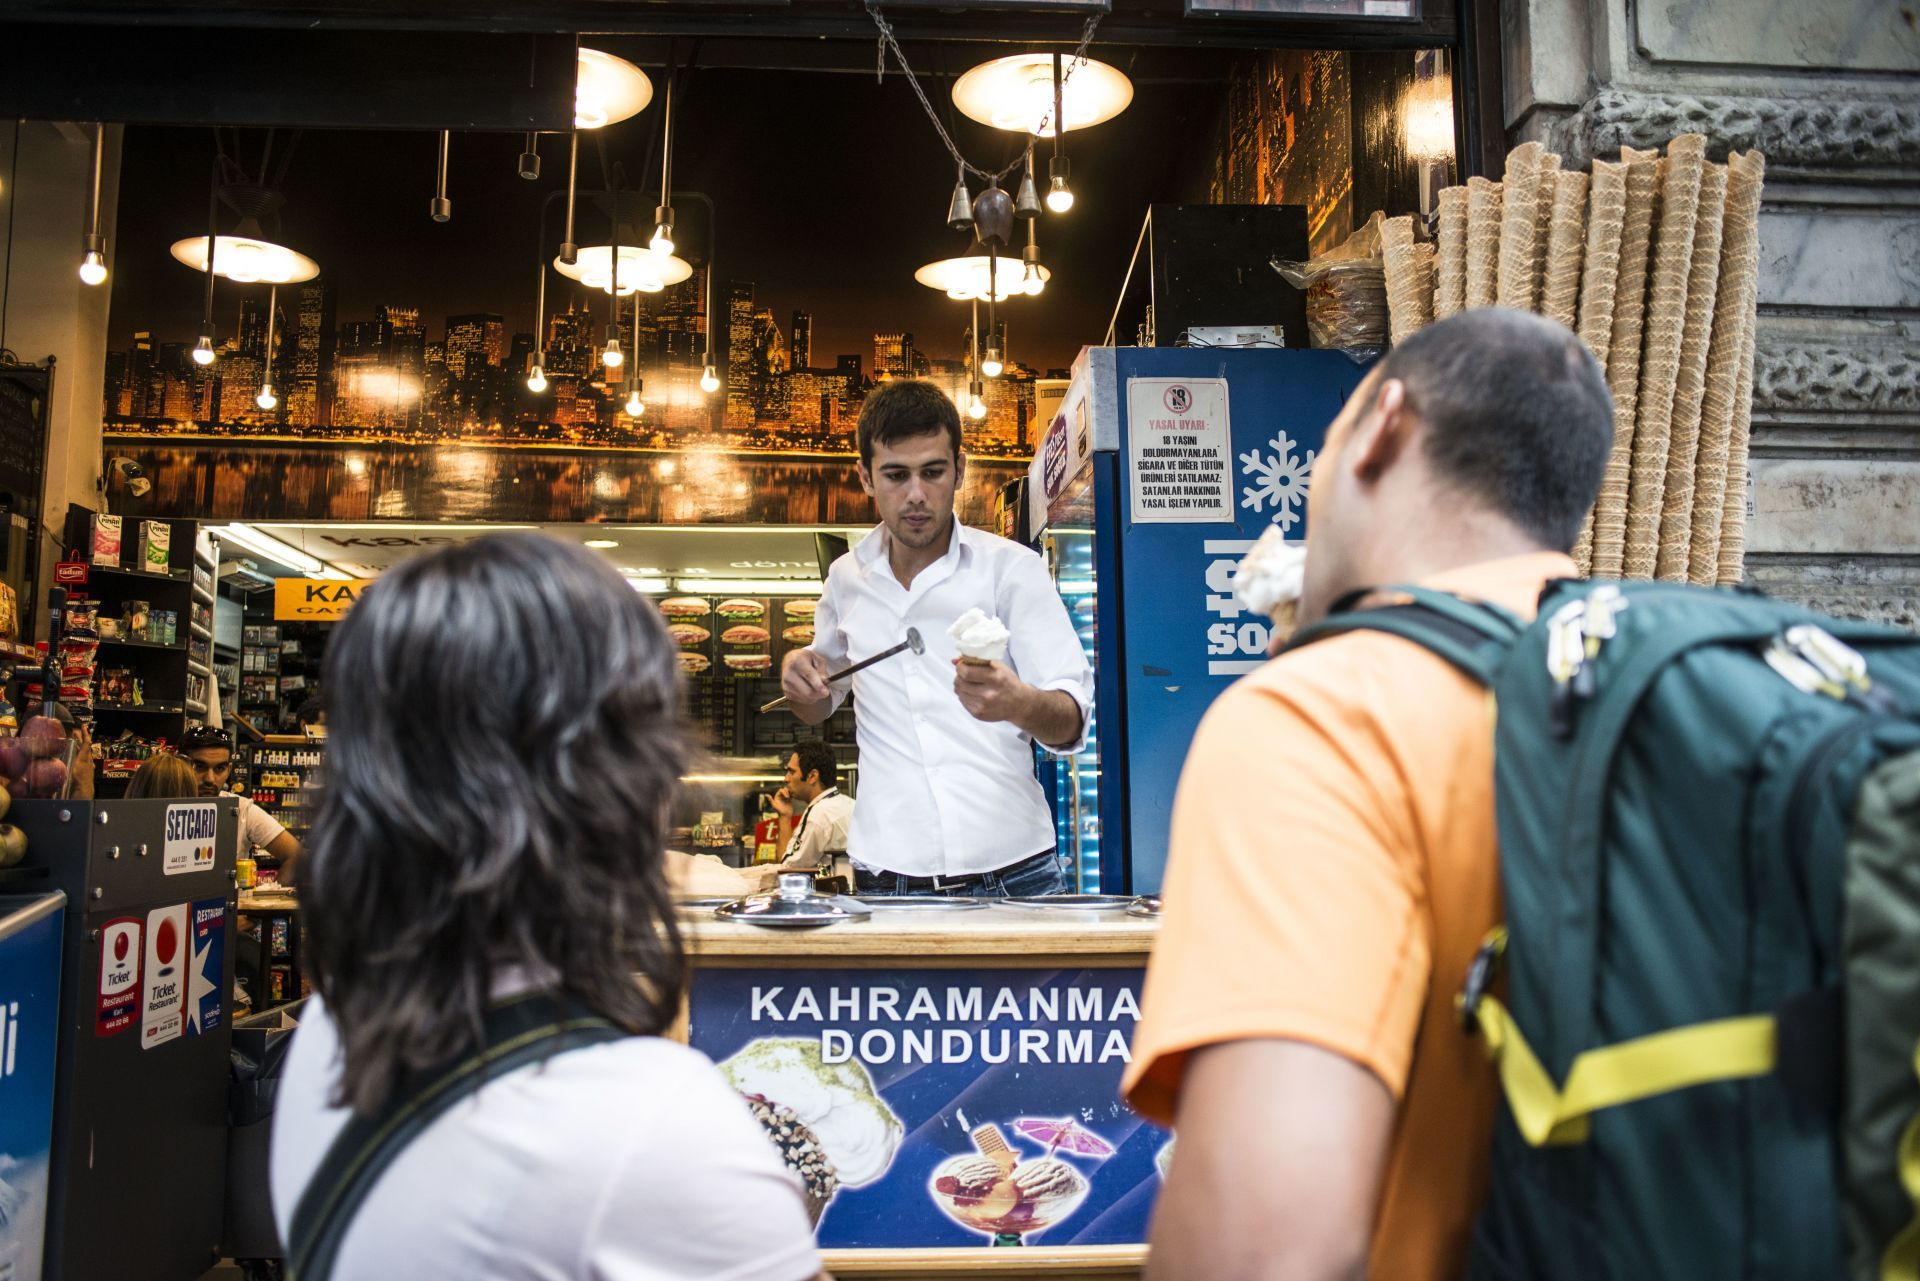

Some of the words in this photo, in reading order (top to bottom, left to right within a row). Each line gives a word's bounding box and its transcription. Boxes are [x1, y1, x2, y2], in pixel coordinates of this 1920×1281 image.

[1149, 419, 1177, 430] YASAL
[1163, 436, 1170, 445] 18
[1173, 436, 1197, 446] YAŞINI
[1143, 448, 1217, 458] DOLDURMAYANLARA
[1138, 459, 1165, 470] SİGARA
[1167, 461, 1176, 470] VE
[1178, 459, 1198, 470] DİĞER
[1201, 460, 1223, 470] TÜTÜN
[1141, 471, 1176, 483] ÜRÜNLERİ
[1143, 486, 1182, 495] SATANLAR
[1184, 486, 1221, 495] HAKKINDA
[1142, 499, 1166, 508] YASAL
[1169, 497, 1190, 509] İŞLEM
[167, 809, 216, 841] SETCARD
[108, 971, 130, 986] Ticket
[152, 982, 176, 1000] Ticket
[102, 992, 135, 1008] Restaurant
[148, 995, 178, 1012] Restaurant
[751, 986, 1142, 1022] KAHRAMANMA
